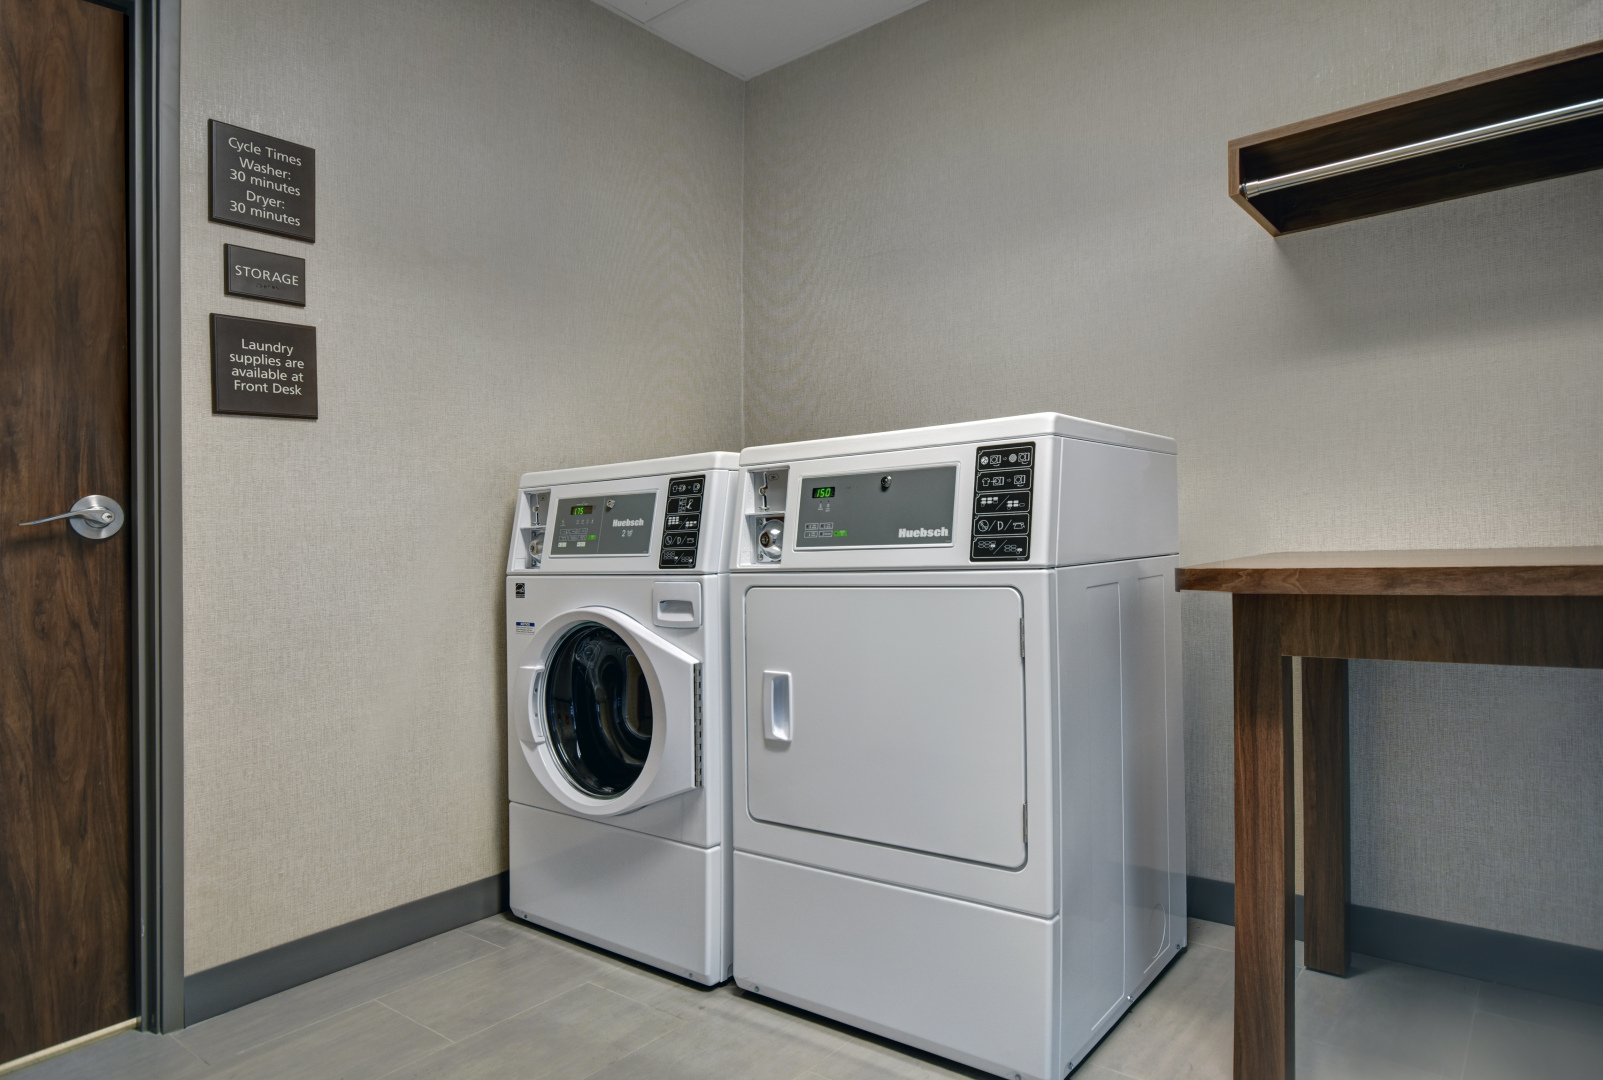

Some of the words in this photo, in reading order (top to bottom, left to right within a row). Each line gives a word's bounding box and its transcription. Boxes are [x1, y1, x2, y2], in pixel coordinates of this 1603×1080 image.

[228, 137, 261, 155] Cycle
[265, 147, 302, 166] Times
[239, 156, 291, 180] Washer:
[229, 168, 246, 182] 30
[250, 174, 301, 196] minutes
[246, 190, 285, 209] Dryer:
[229, 200, 246, 214] 30
[250, 207, 301, 227] minutes
[235, 264, 299, 286] STORAGE
[241, 338, 293, 357] Laundry
[229, 353, 281, 367] supplies
[285, 359, 305, 369] are
[231, 367, 288, 381] available
[291, 372, 304, 383] at
[234, 379, 268, 393] Front
[272, 382, 302, 396] Desk
[816, 487, 832, 498] 150
[612, 518, 645, 527] Huebsch
[898, 526, 949, 538] Huebsch
